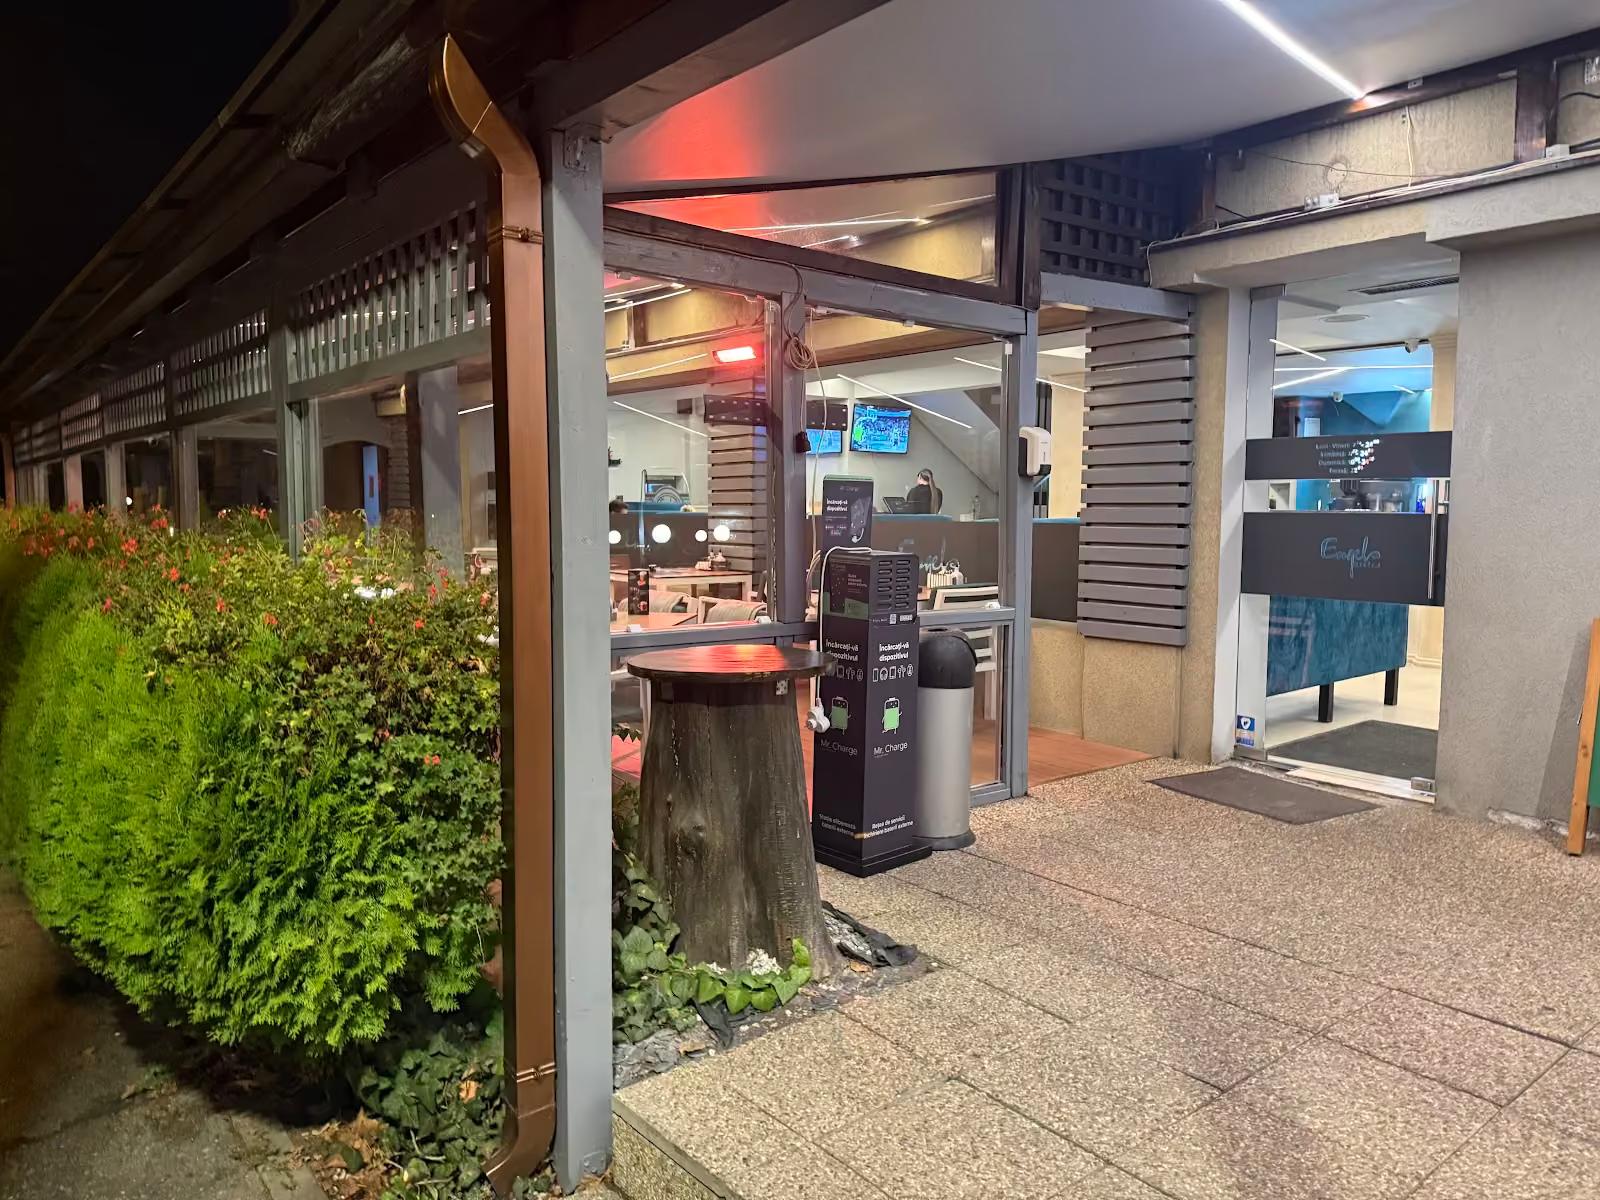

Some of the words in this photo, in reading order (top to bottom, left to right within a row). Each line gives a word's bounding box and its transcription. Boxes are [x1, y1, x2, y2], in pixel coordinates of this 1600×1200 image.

[879, 652, 909, 662] dispozitivul
[873, 746, 884, 755] Mr.
[884, 742, 908, 752] Charge
